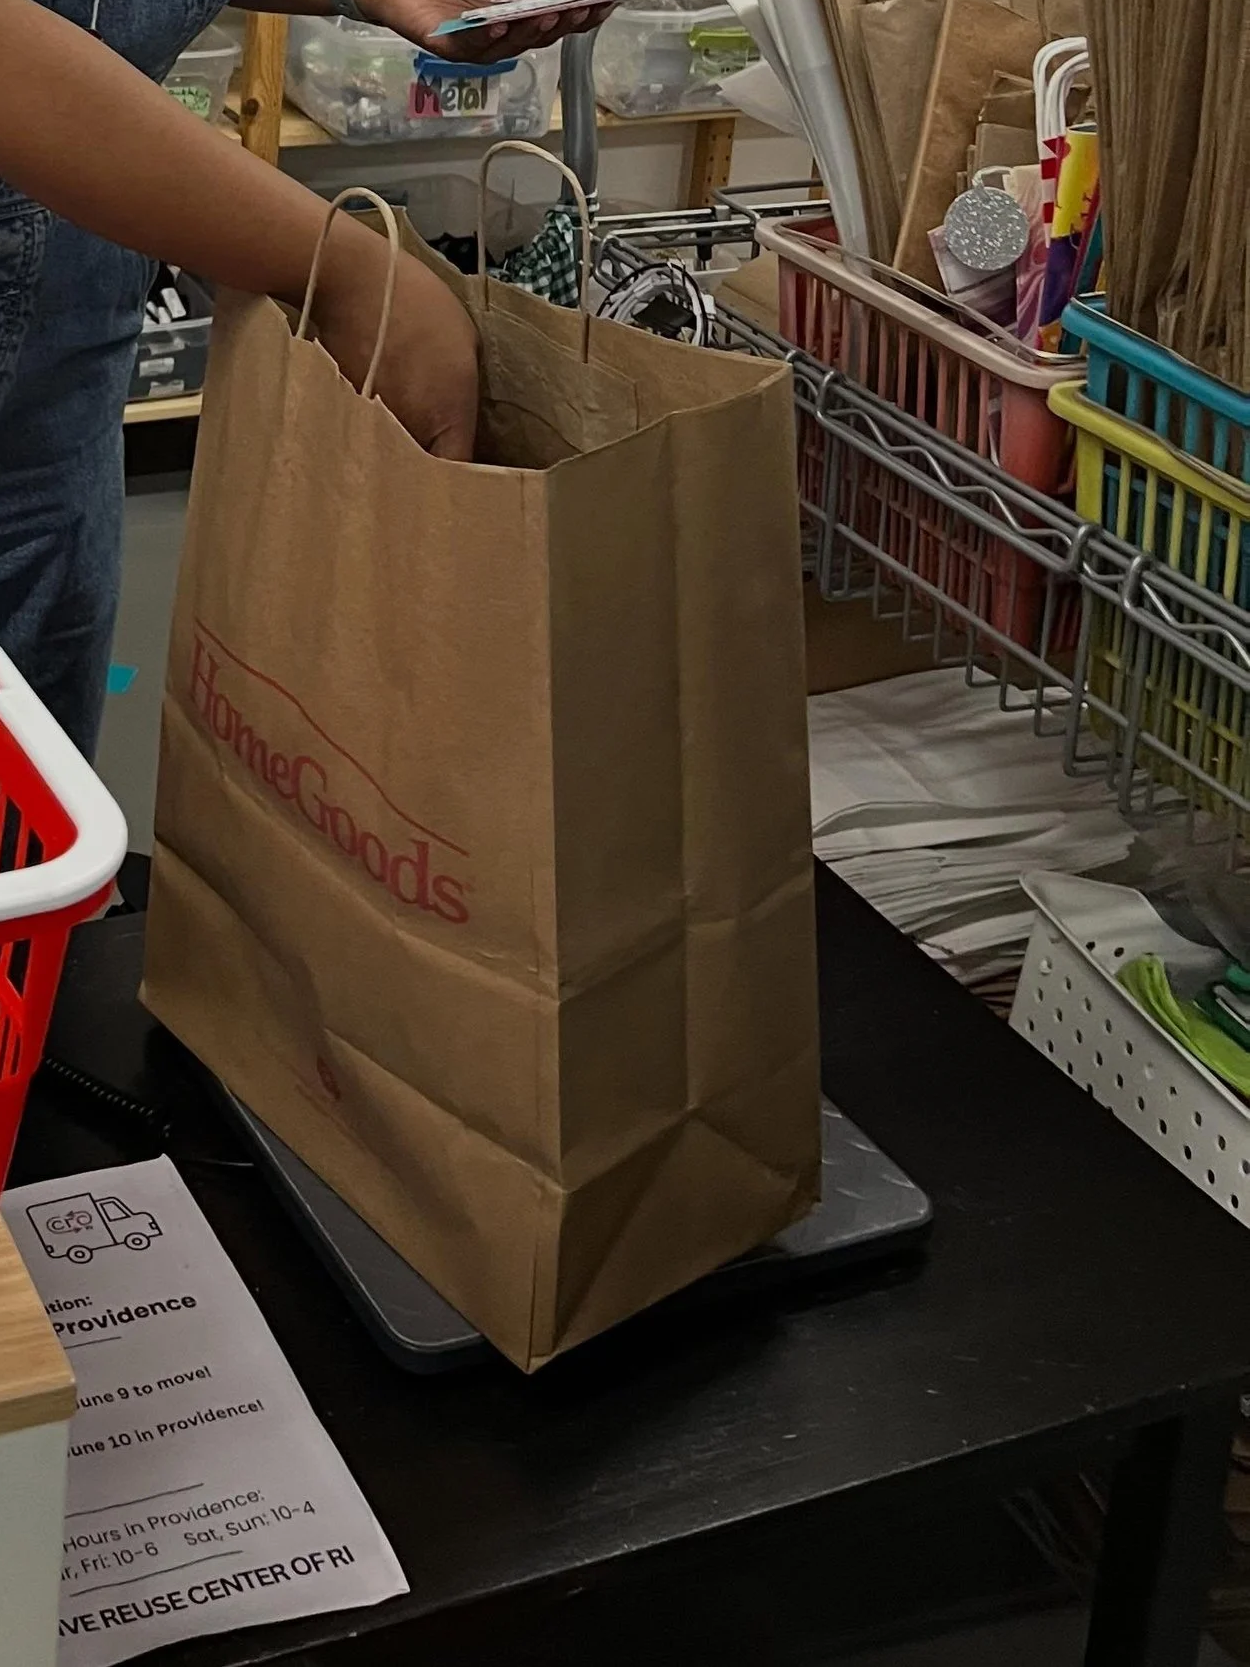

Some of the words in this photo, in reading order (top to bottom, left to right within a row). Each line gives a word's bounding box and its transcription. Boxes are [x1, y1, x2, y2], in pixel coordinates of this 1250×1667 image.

[414, 73, 488, 114] Metal
[190, 633, 470, 925] HomeGoods
[53, 1295, 197, 1337] Providence
[117, 1387, 130, 1400] 9
[134, 1384, 153, 1397] to
[156, 1365, 213, 1391] move!
[108, 1433, 132, 1449] 10
[136, 1429, 155, 1443] in
[156, 1398, 265, 1437] Providence!
[62, 1527, 122, 1553] Hours
[126, 1521, 145, 1537] in
[146, 1489, 265, 1531] Providence:
[184, 1526, 223, 1546] Sat,
[271, 1500, 316, 1523] 10-4
[81, 1555, 110, 1575] Fri:
[112, 1541, 159, 1566] 10-6
[99, 1591, 189, 1629] REUSE
[187, 1562, 293, 1605] CENTER
[290, 1551, 331, 1577] OF
[329, 1544, 356, 1570] RI
